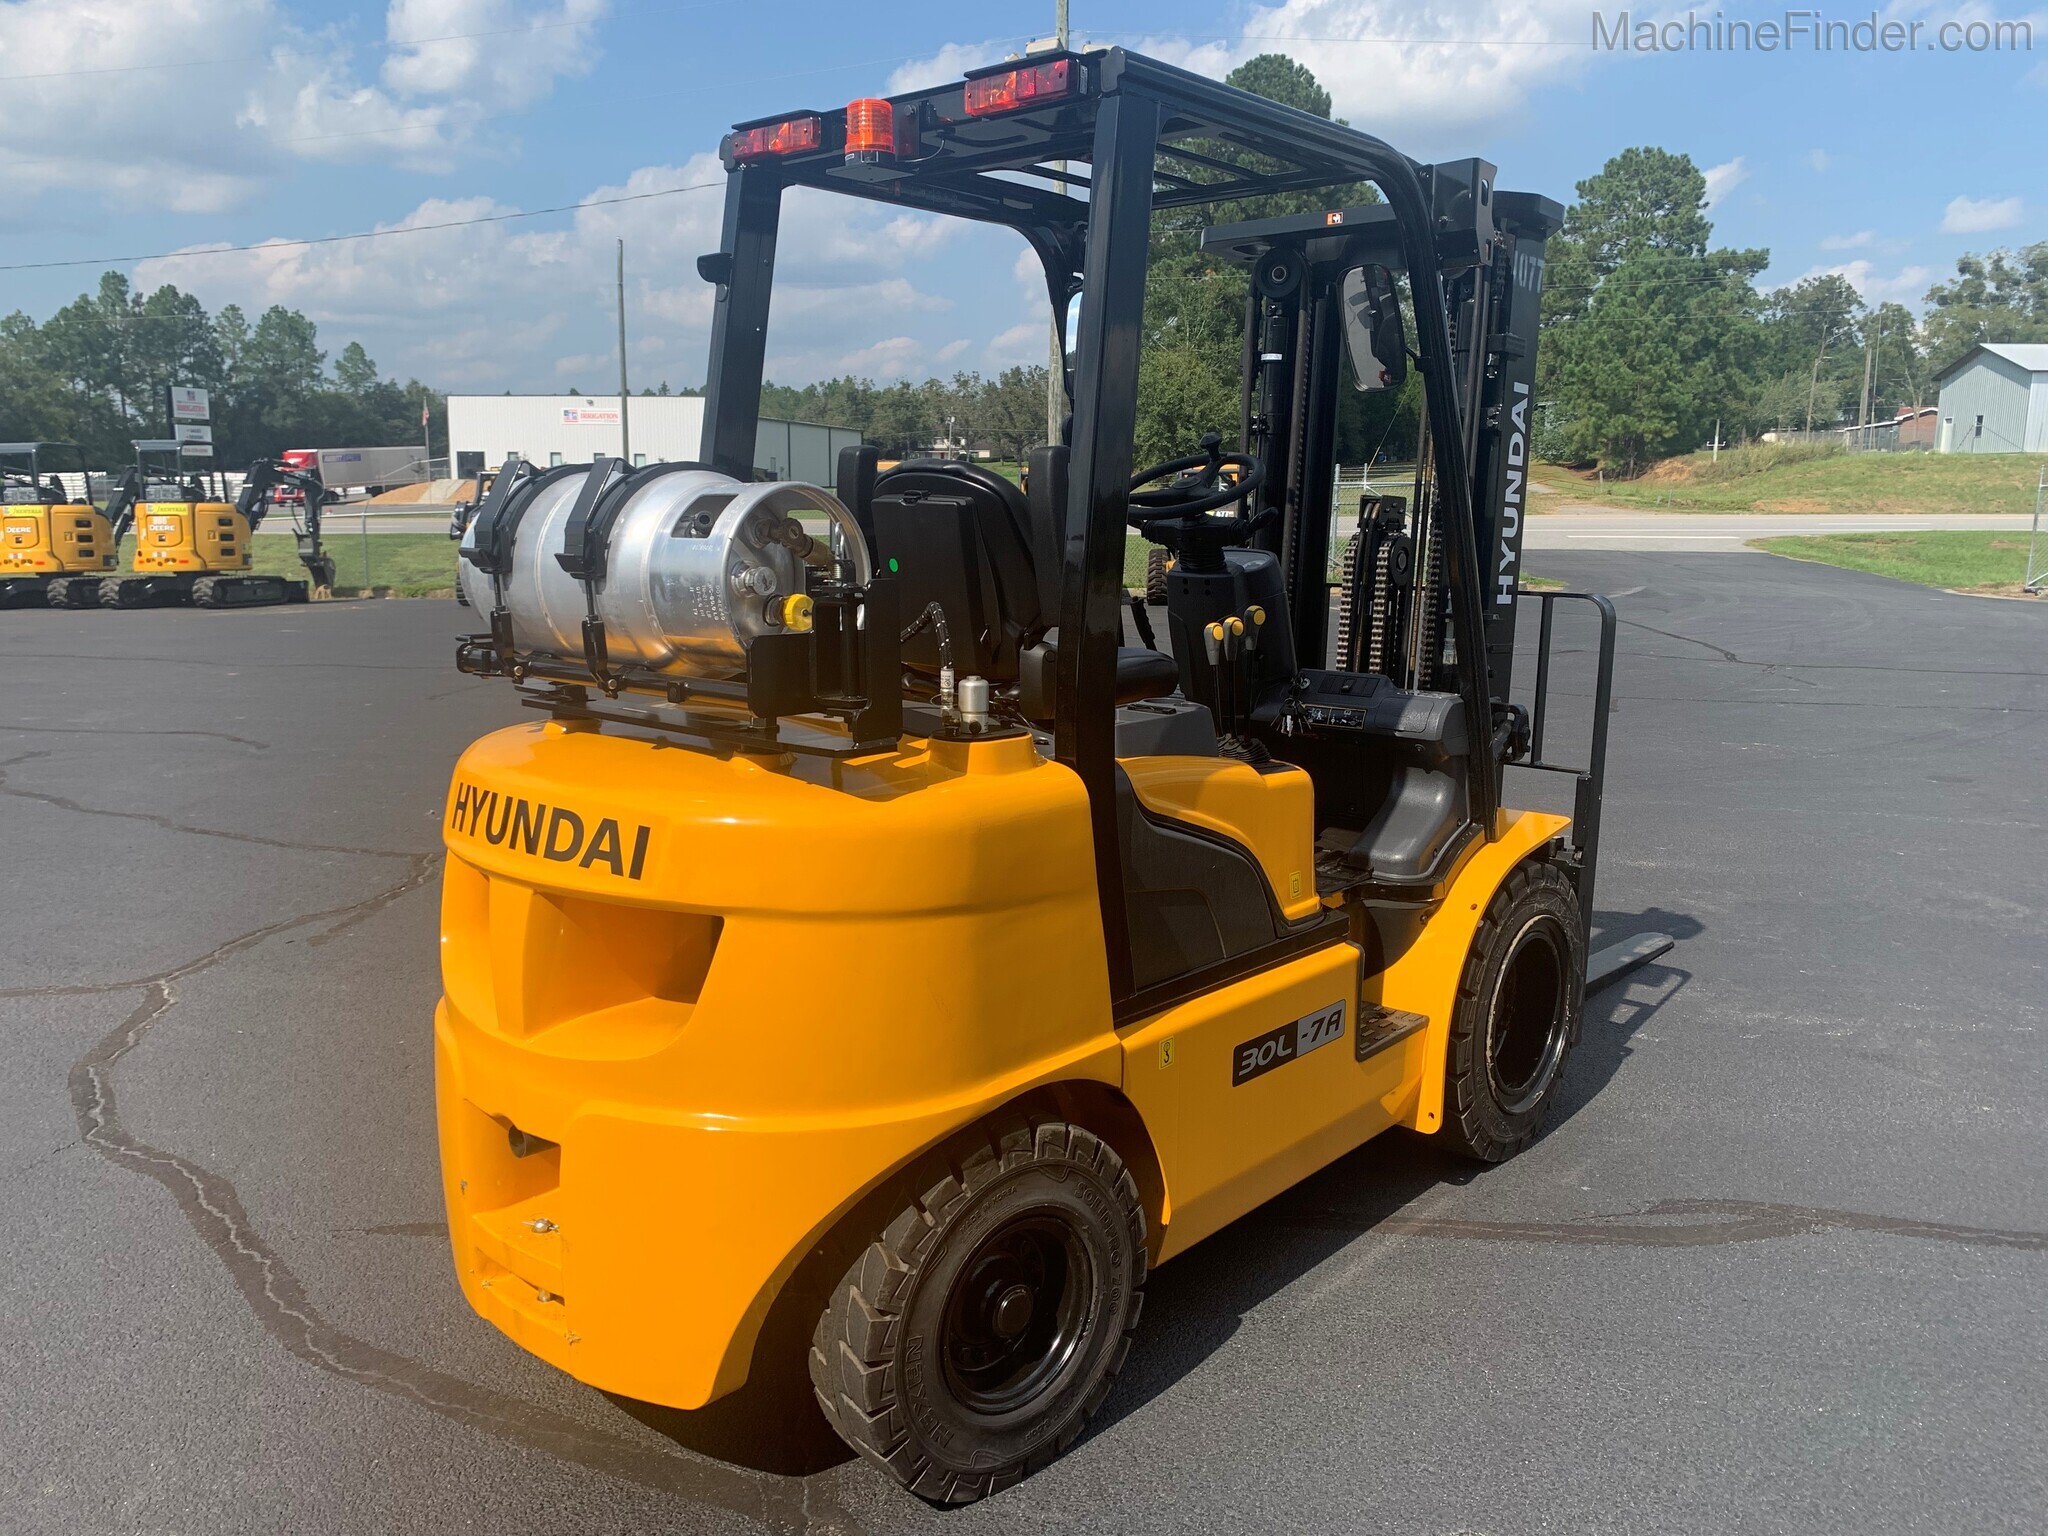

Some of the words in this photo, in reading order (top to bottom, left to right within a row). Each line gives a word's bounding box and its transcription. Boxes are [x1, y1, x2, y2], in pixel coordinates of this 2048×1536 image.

[1497, 382, 1529, 604] HYUNDAI
[452, 782, 651, 880] HYUNDAI
[959, 1210, 982, 1234] MADE
[991, 1185, 1018, 1205] KOREA
[1073, 1181, 1122, 1269] SOLIDPRO
[905, 1335, 955, 1448] NEXEN
